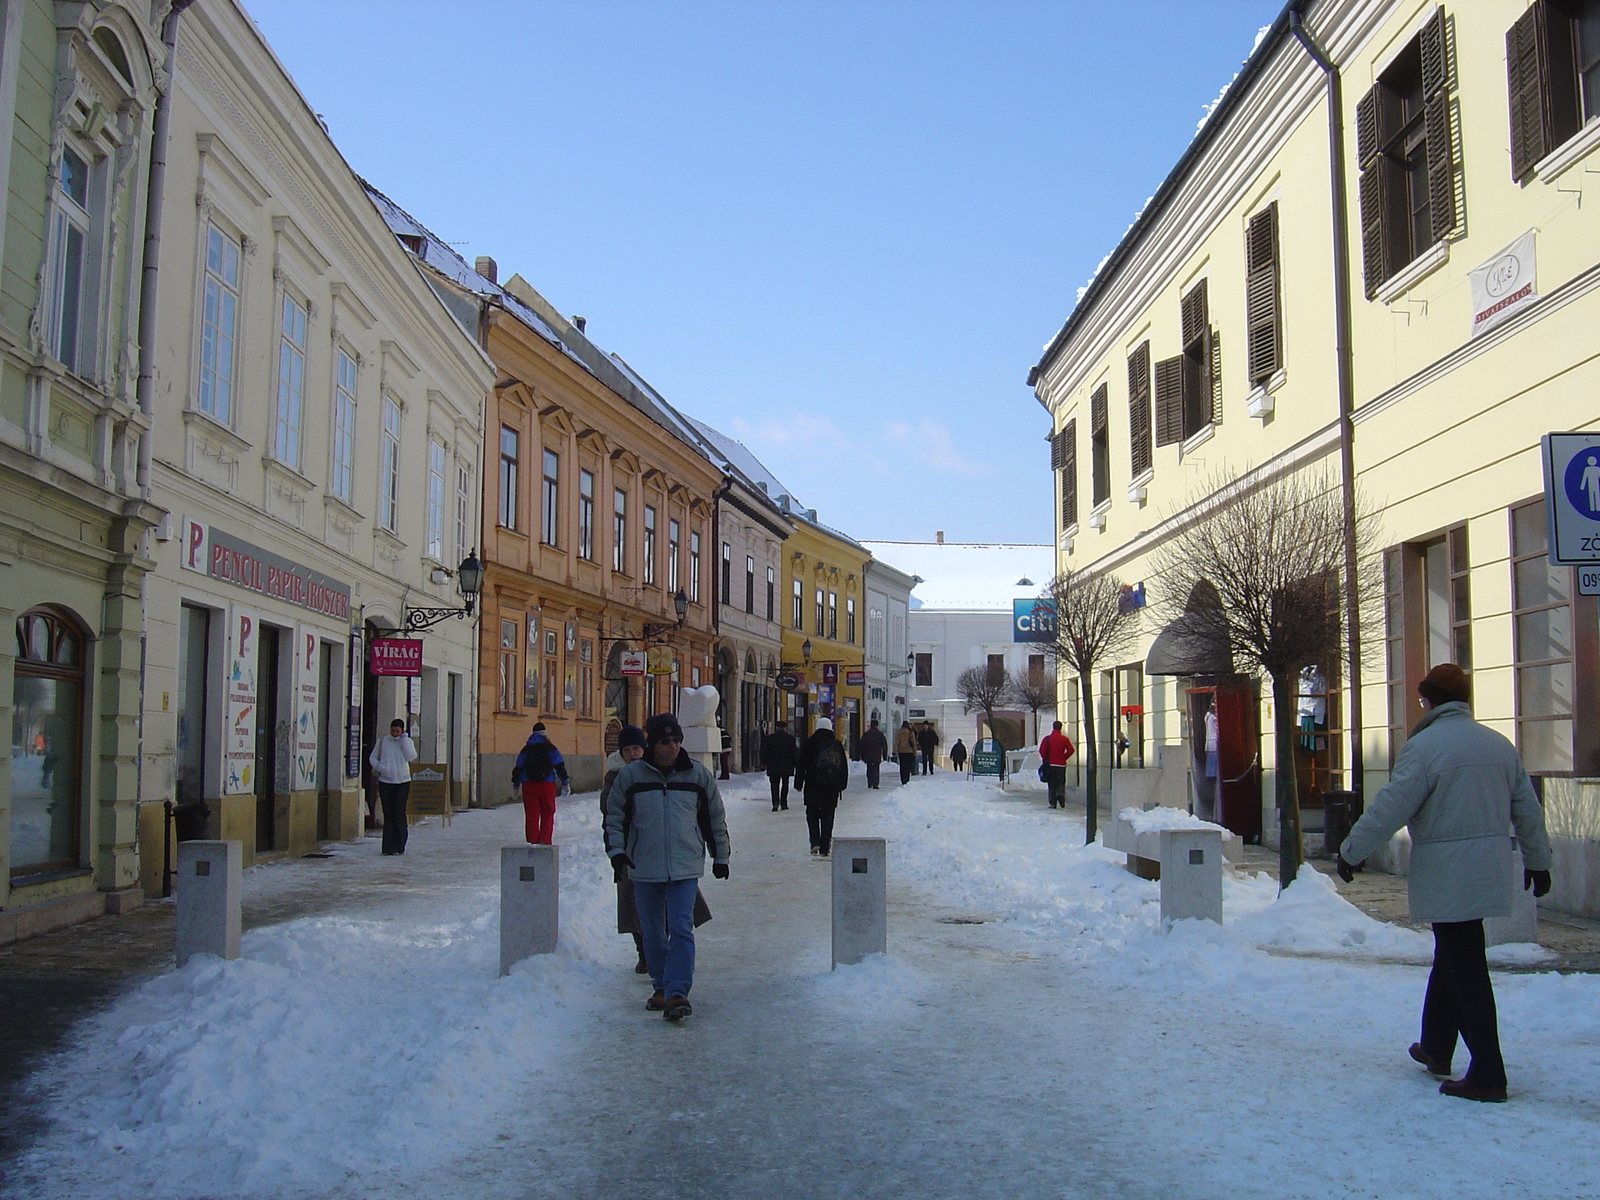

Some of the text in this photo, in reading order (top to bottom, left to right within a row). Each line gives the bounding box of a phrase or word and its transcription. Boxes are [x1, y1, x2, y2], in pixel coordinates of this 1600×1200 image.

[188, 521, 203, 568] P
[211, 543, 348, 621] PENCIL PAPÍR-ÍRÓSZER
[238, 615, 251, 658] P
[1017, 611, 1053, 632] citi
[305, 633, 315, 671] P
